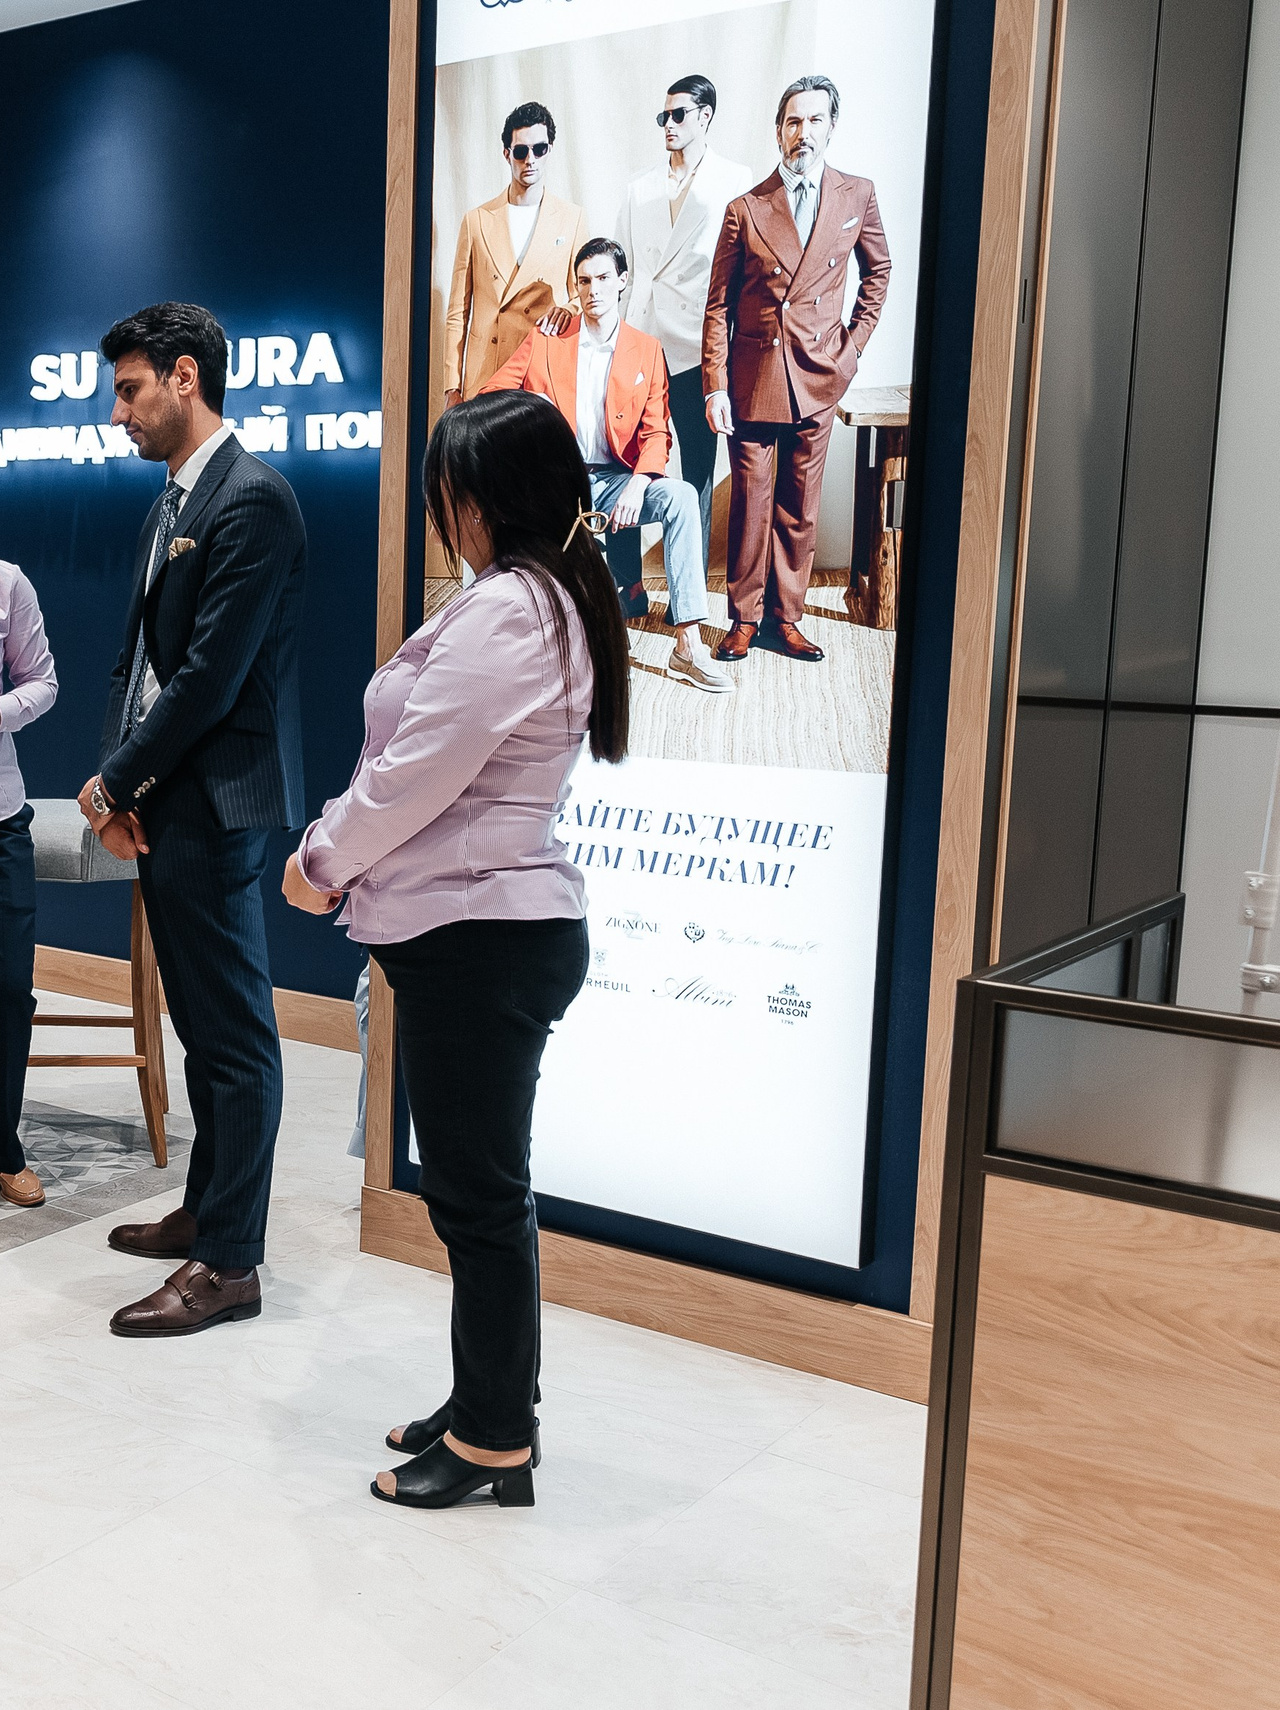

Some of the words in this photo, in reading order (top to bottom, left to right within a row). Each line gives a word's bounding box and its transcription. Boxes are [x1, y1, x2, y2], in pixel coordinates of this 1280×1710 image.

[30, 350, 98, 402] SU
[225, 331, 345, 390] URA
[661, 811, 834, 854] БУДУЩЕЕ
[565, 841, 624, 871] ИМ
[631, 849, 796, 890] МЕРКАМ!
[585, 977, 631, 993] RMEUIL
[767, 995, 812, 1010] THOMAS
[768, 1005, 808, 1018] MASON
